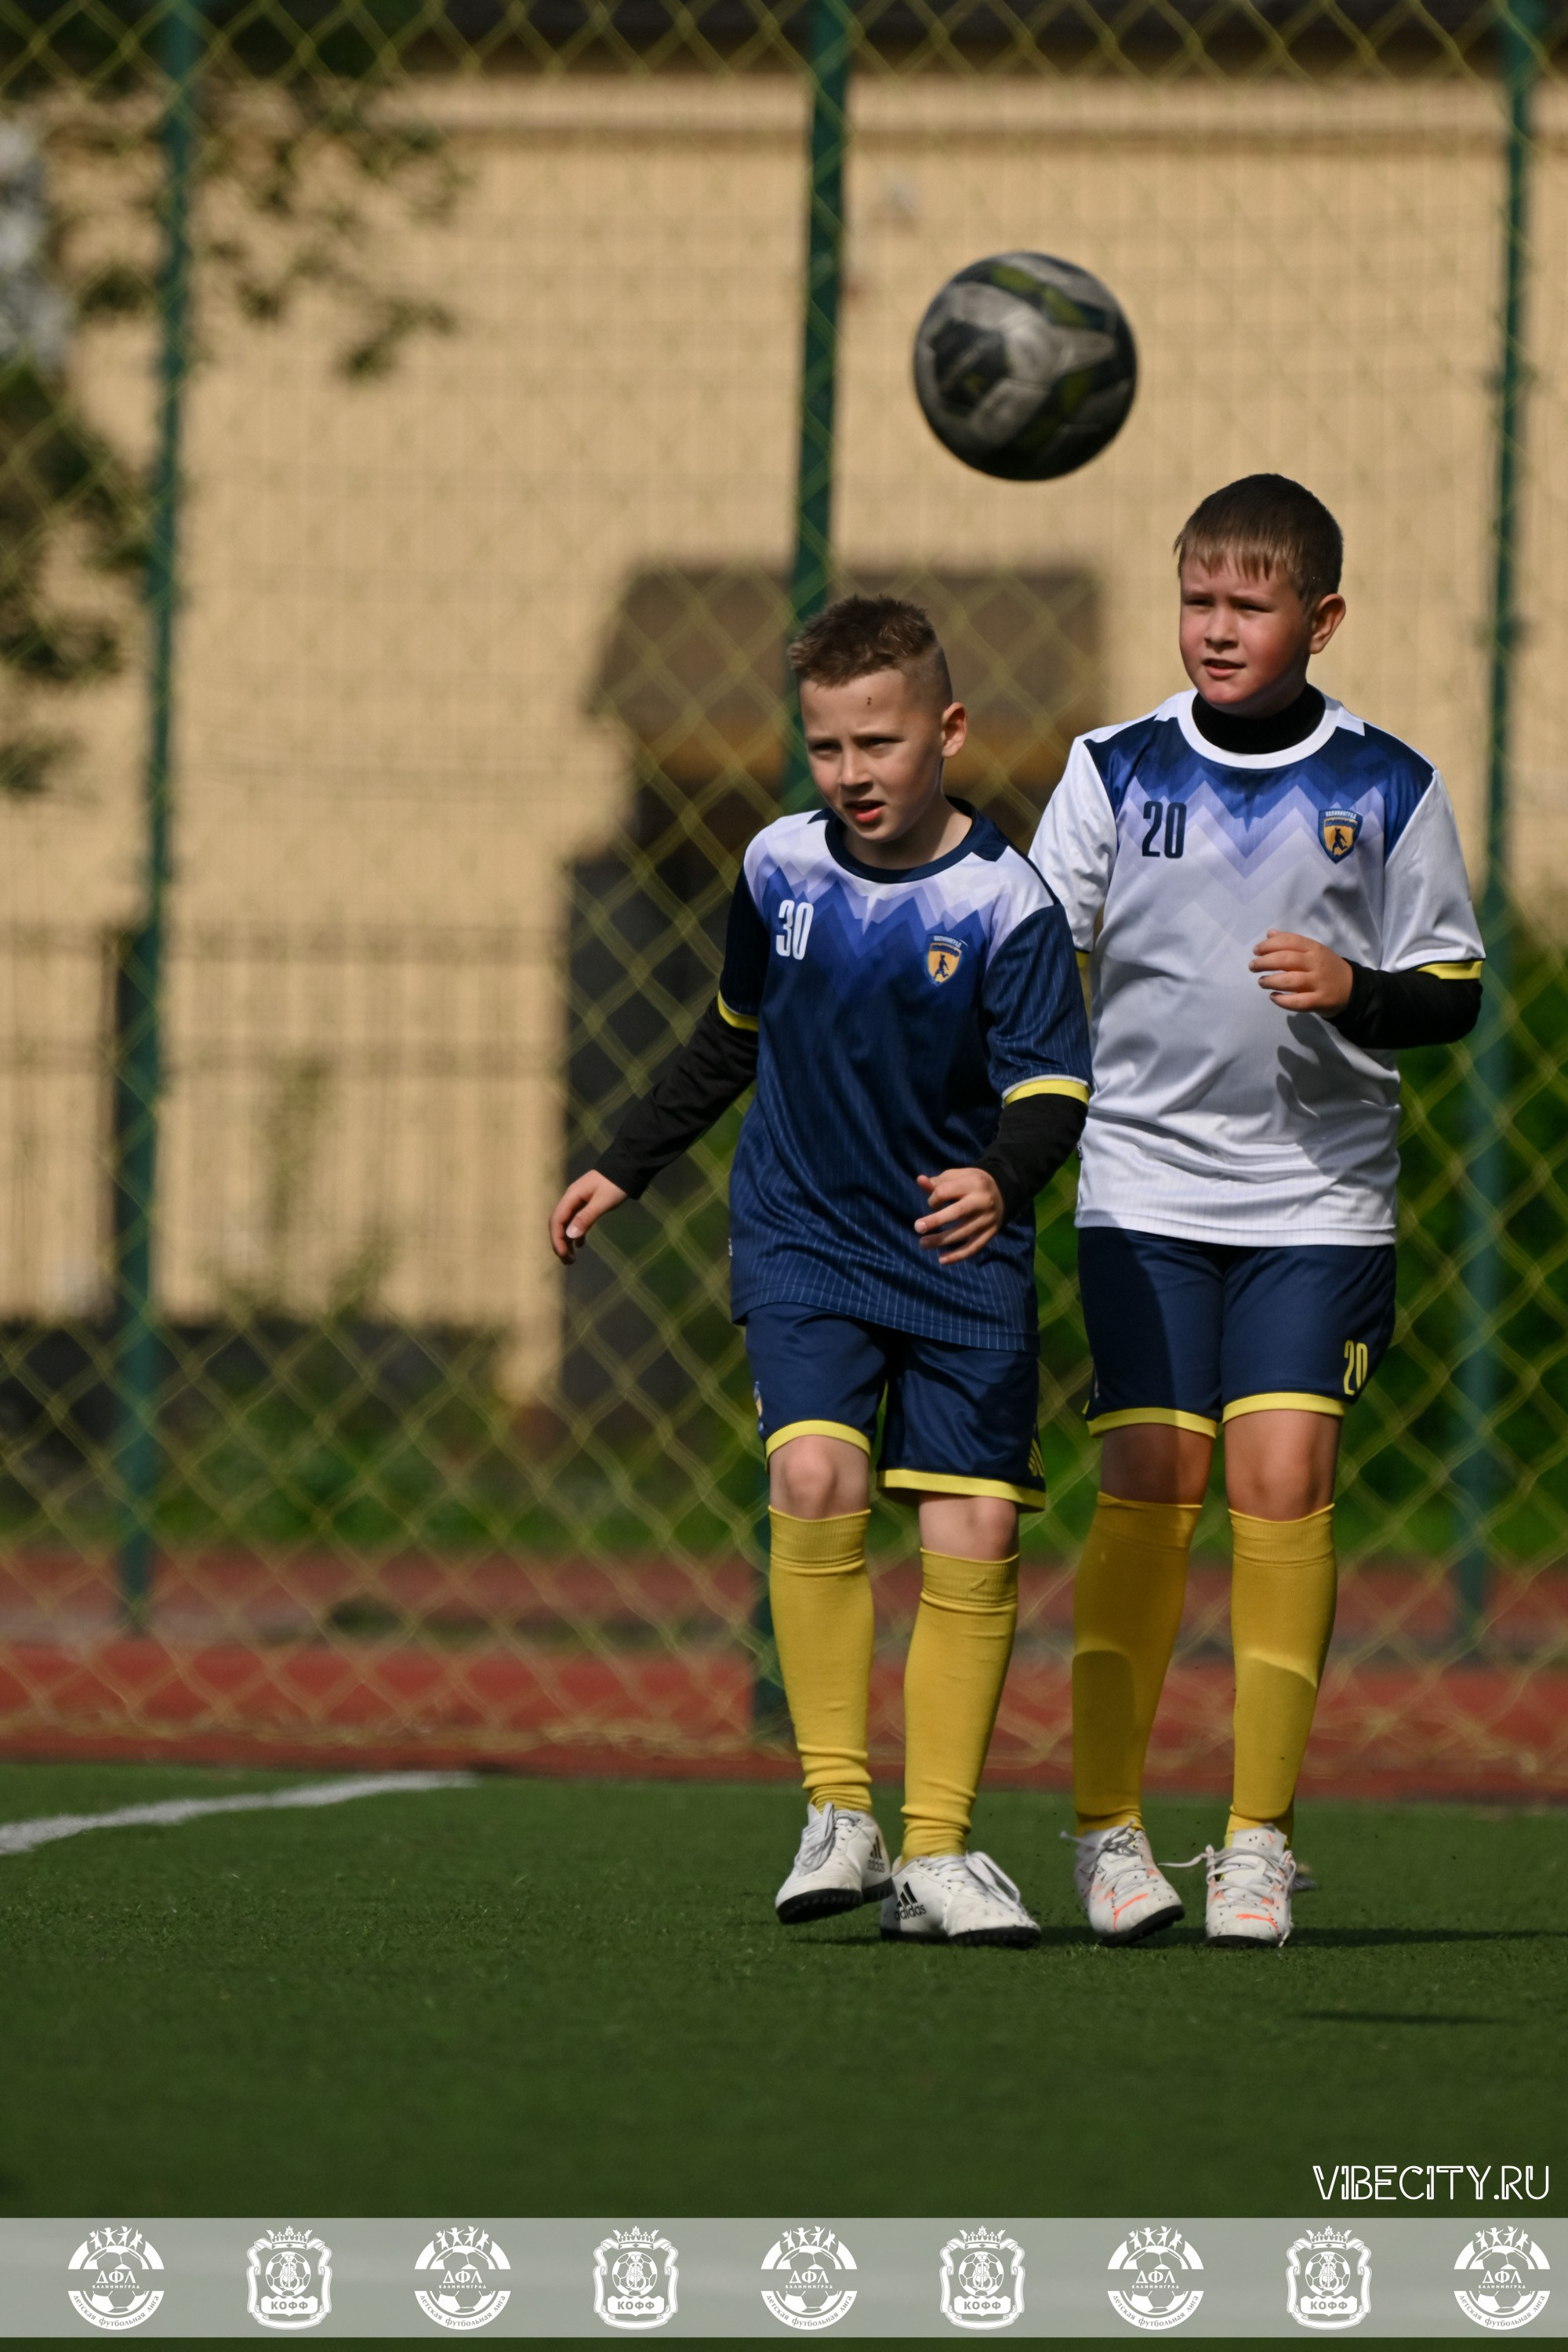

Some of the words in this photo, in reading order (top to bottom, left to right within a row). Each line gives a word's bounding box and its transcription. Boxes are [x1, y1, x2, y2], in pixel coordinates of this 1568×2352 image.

[1142, 800, 1187, 859] 20
[775, 899, 815, 960] 30
[1343, 1339, 1368, 1396] 20
[895, 1904, 927, 1922] adidas
